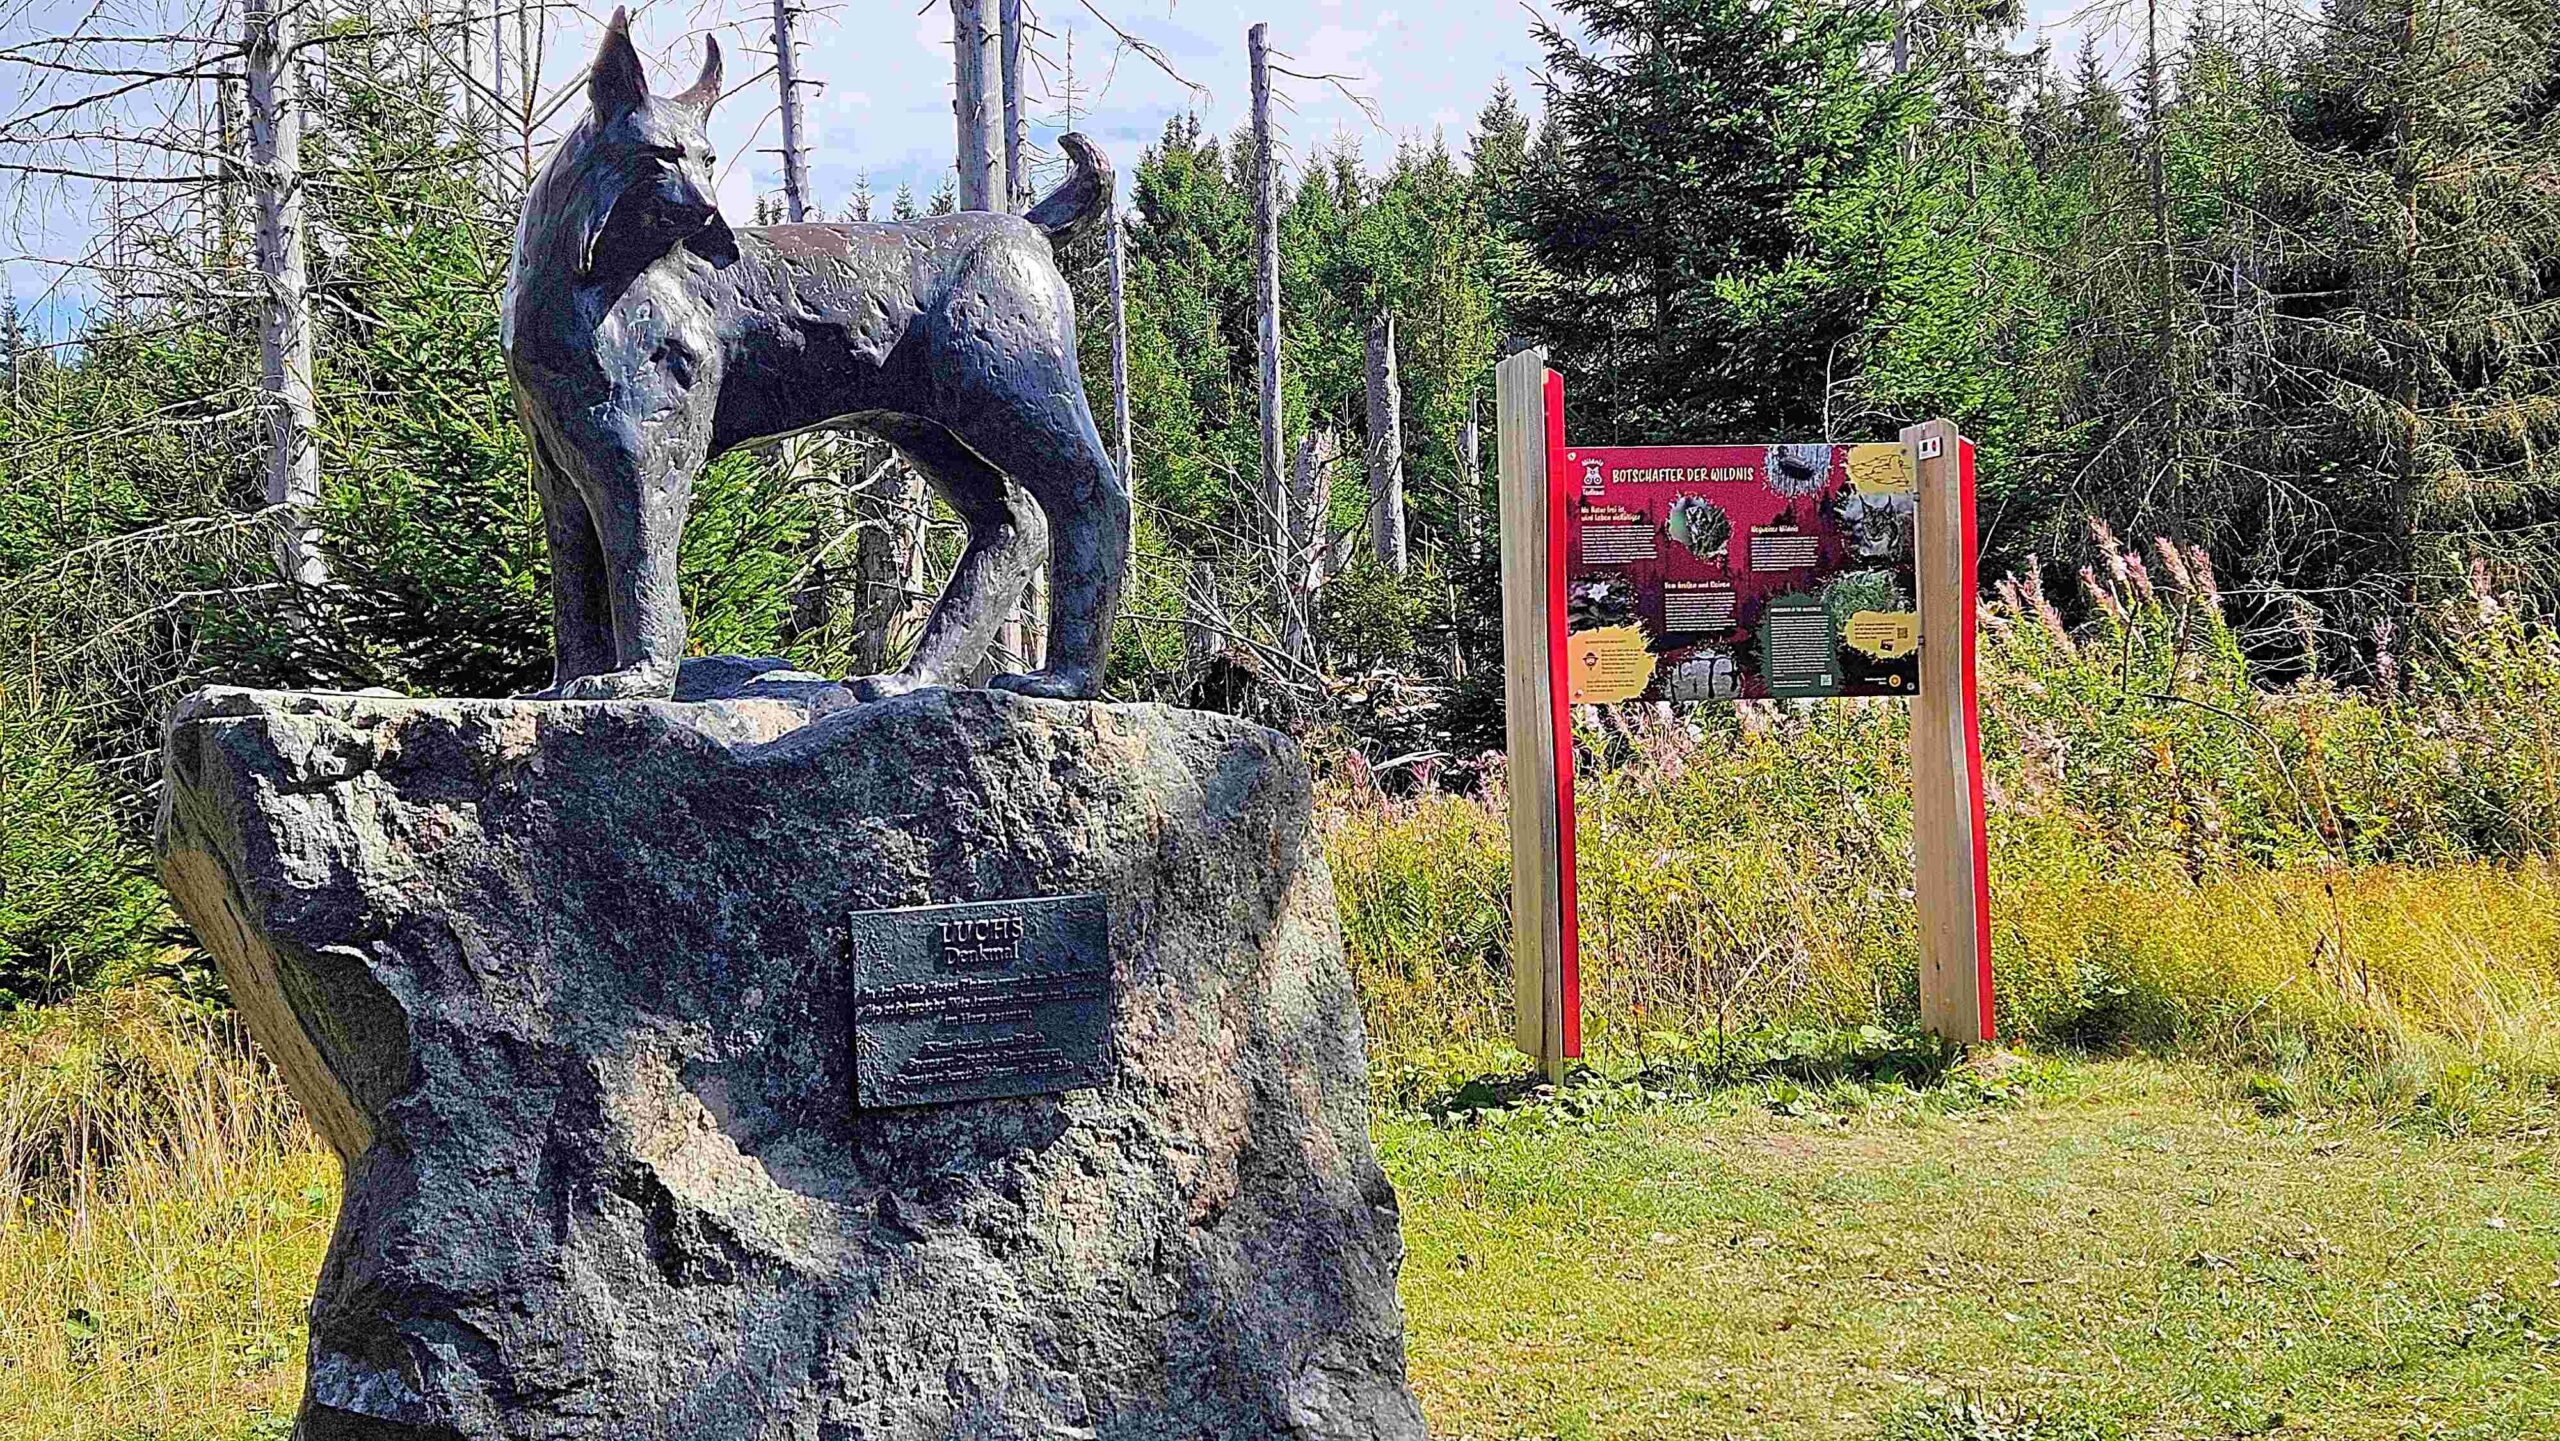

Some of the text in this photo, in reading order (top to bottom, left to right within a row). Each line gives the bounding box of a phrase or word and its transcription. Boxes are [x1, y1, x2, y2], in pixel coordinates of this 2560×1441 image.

[1612, 467, 1754, 484] BOTSCHAFTER DER WILDNIS
[937, 916, 1024, 943] LUCHS
[944, 940, 1020, 965] Denkmal
